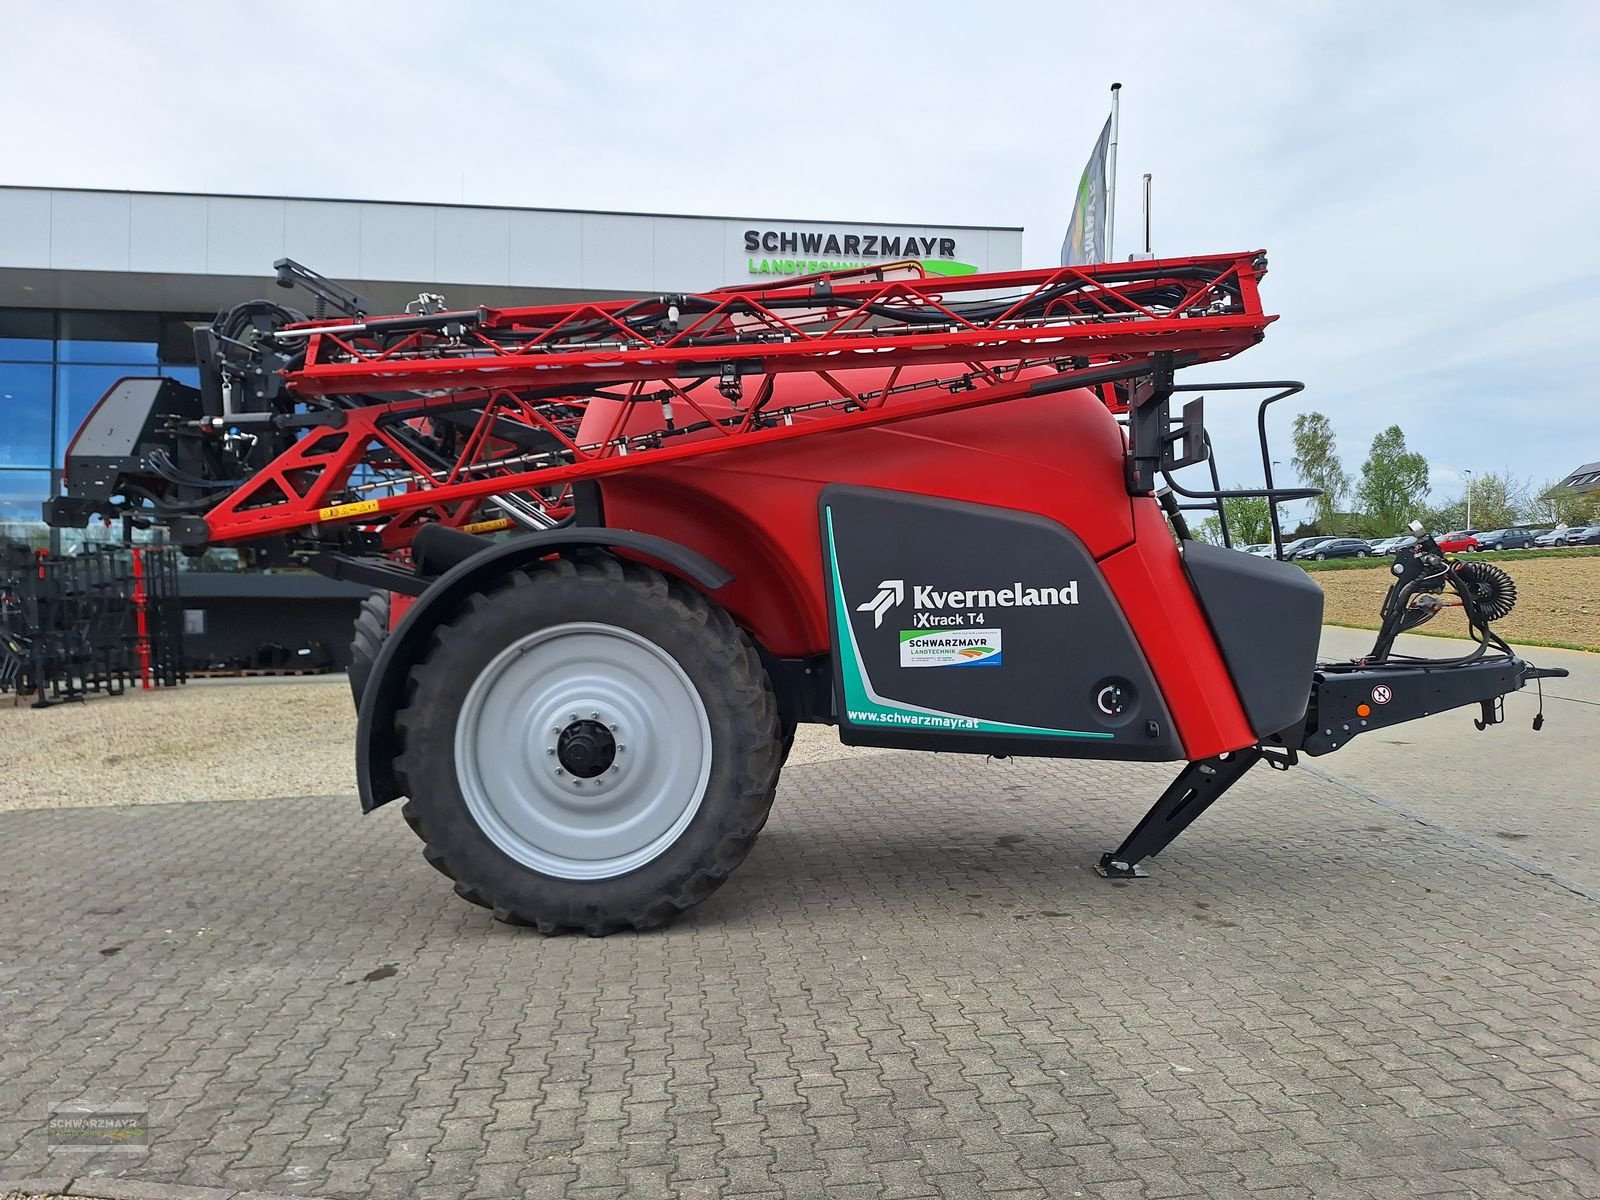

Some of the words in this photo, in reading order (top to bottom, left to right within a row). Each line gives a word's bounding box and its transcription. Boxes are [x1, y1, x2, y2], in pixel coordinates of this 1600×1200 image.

[744, 230, 956, 257] SCHWARZMAYR
[913, 580, 1079, 609] Kverneland
[913, 612, 964, 628] iXtrack
[967, 613, 985, 625] T4
[909, 638, 987, 648] SCHWARZMAYR
[847, 710, 979, 730] www.schwarzmayr.at
